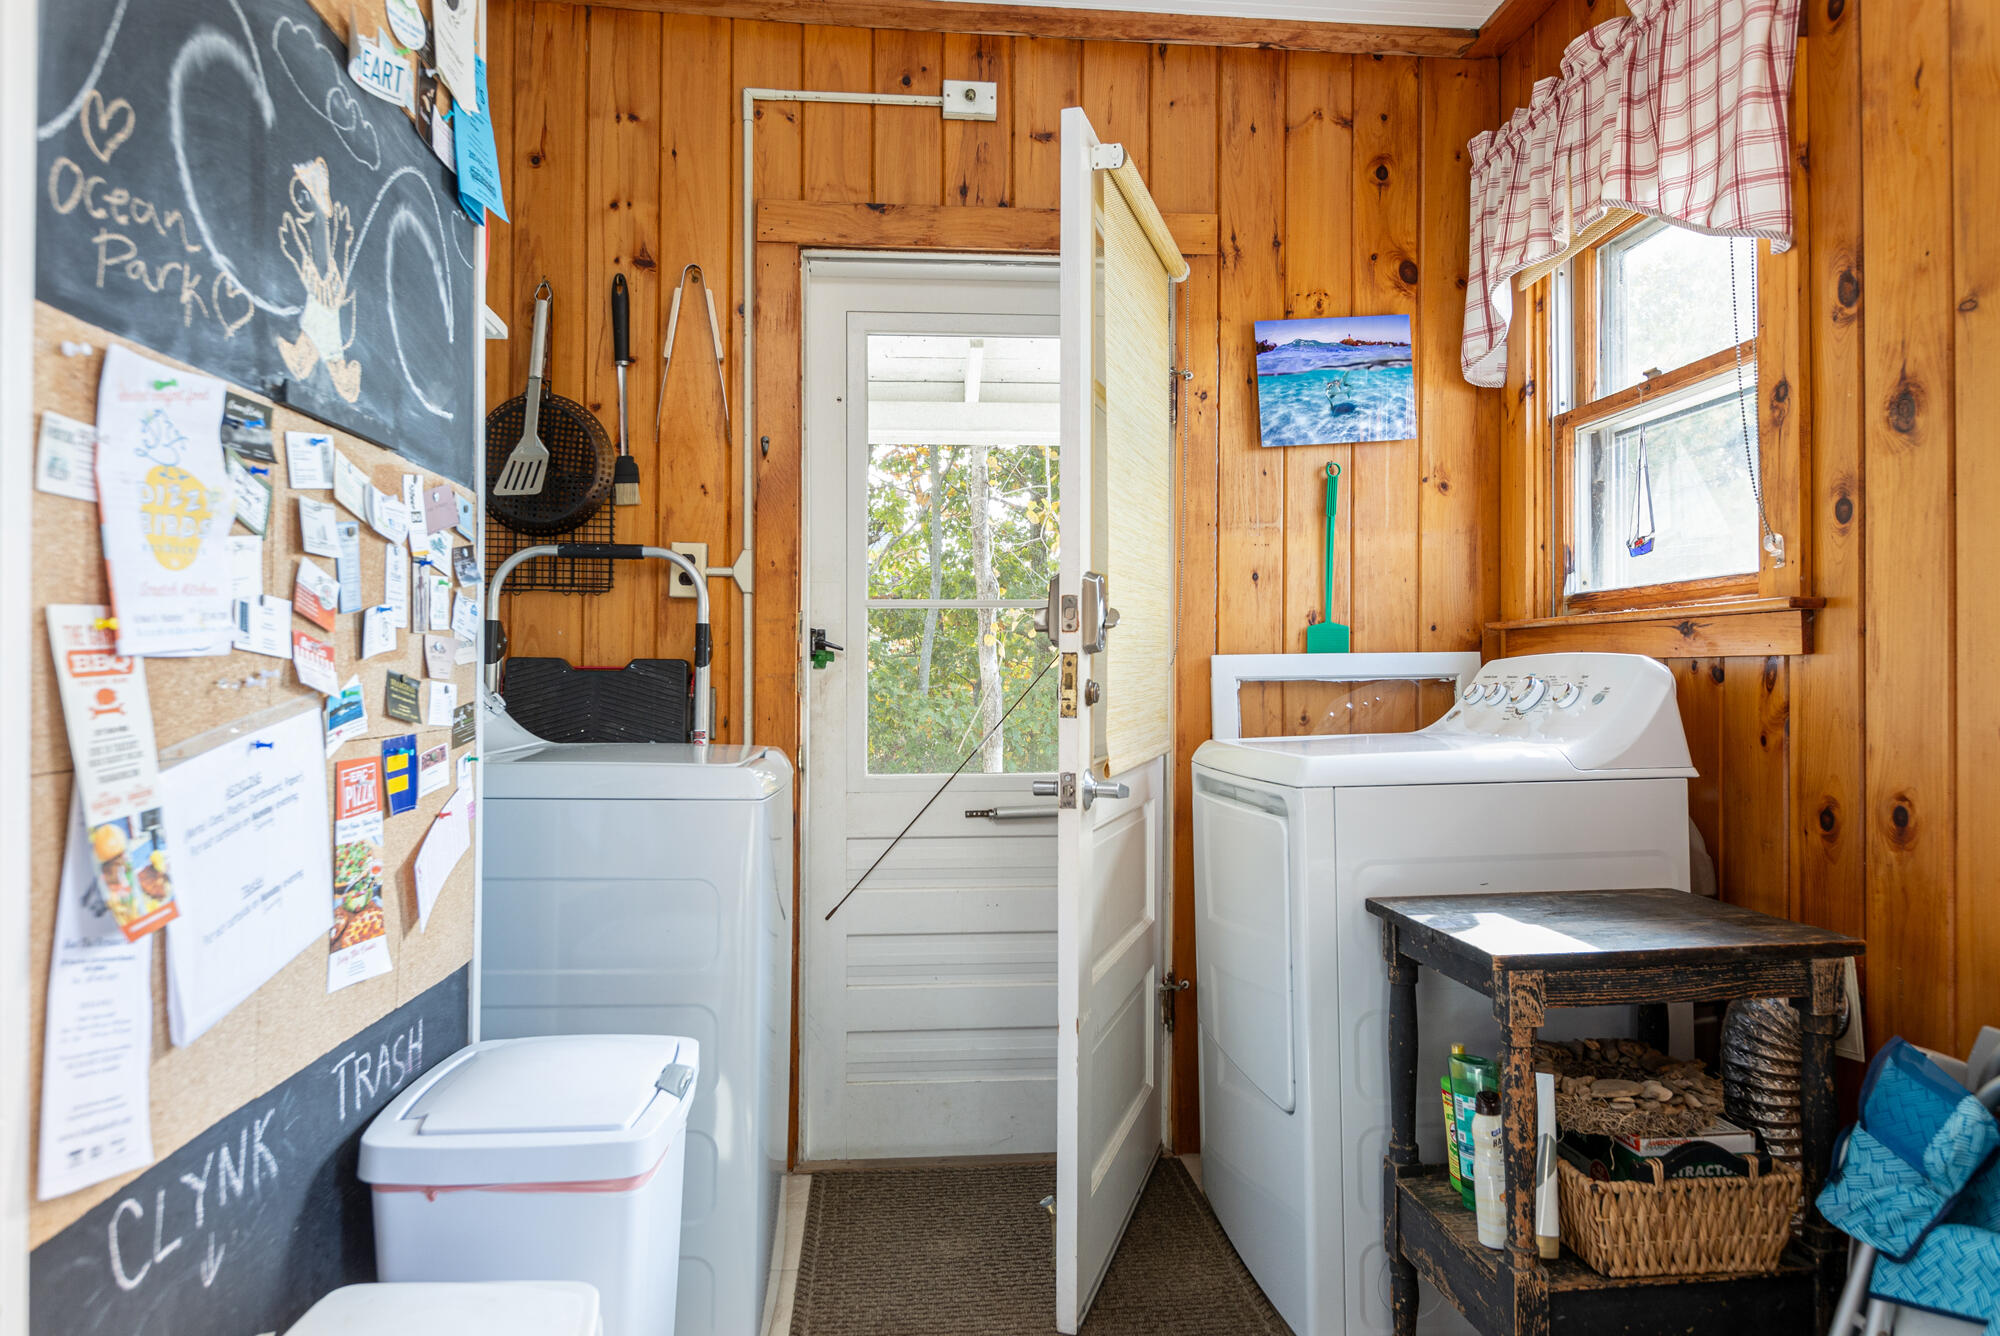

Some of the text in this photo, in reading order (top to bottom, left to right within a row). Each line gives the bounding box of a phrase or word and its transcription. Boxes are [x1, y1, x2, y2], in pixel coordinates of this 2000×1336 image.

[356, 49, 405, 93] EART
[48, 157, 202, 252] Ocean
[91, 228, 210, 328] Park
[70, 653, 132, 674] BBQ
[345, 781, 377, 810] PIZZA
[331, 1018, 424, 1120] TRASH
[108, 1108, 280, 1291] CLYNK
[1671, 1164, 1738, 1178] TRACTO
